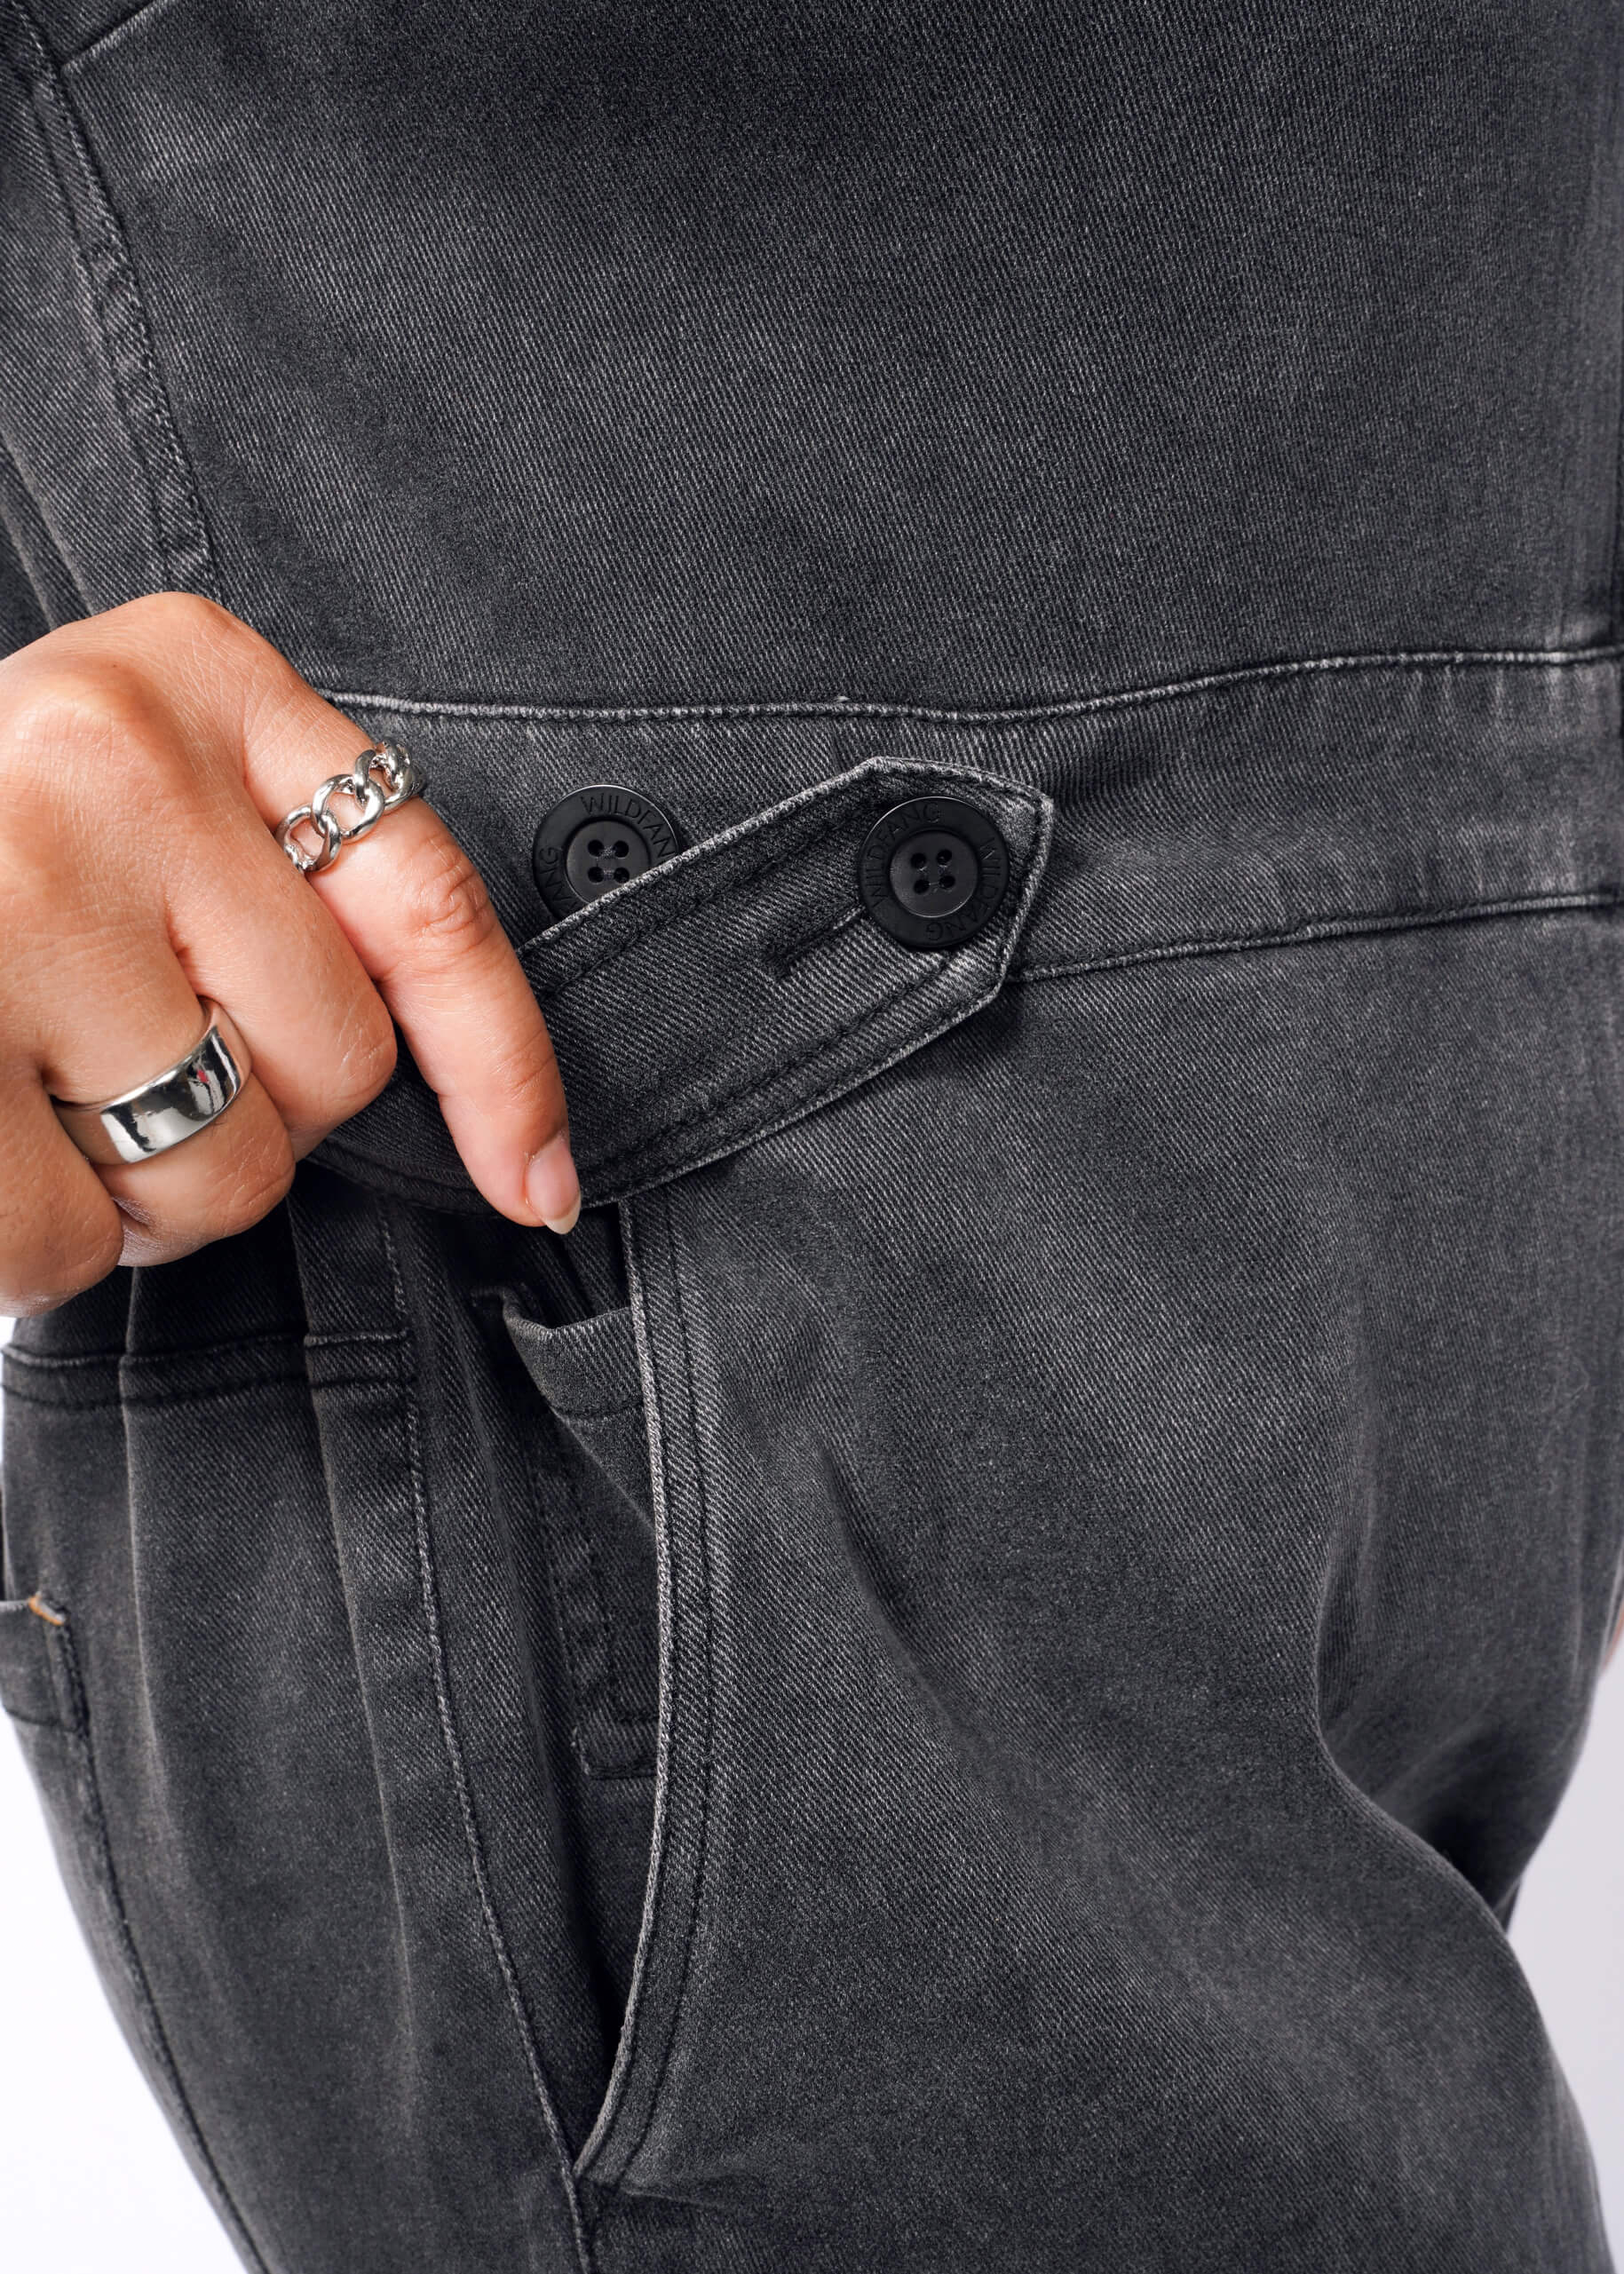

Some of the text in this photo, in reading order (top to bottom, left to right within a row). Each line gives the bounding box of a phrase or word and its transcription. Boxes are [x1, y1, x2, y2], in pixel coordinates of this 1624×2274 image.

[580, 793, 676, 859] WILDFAN
[866, 802, 940, 907] WILDFANG
[926, 836, 1001, 940] WILDFANG
